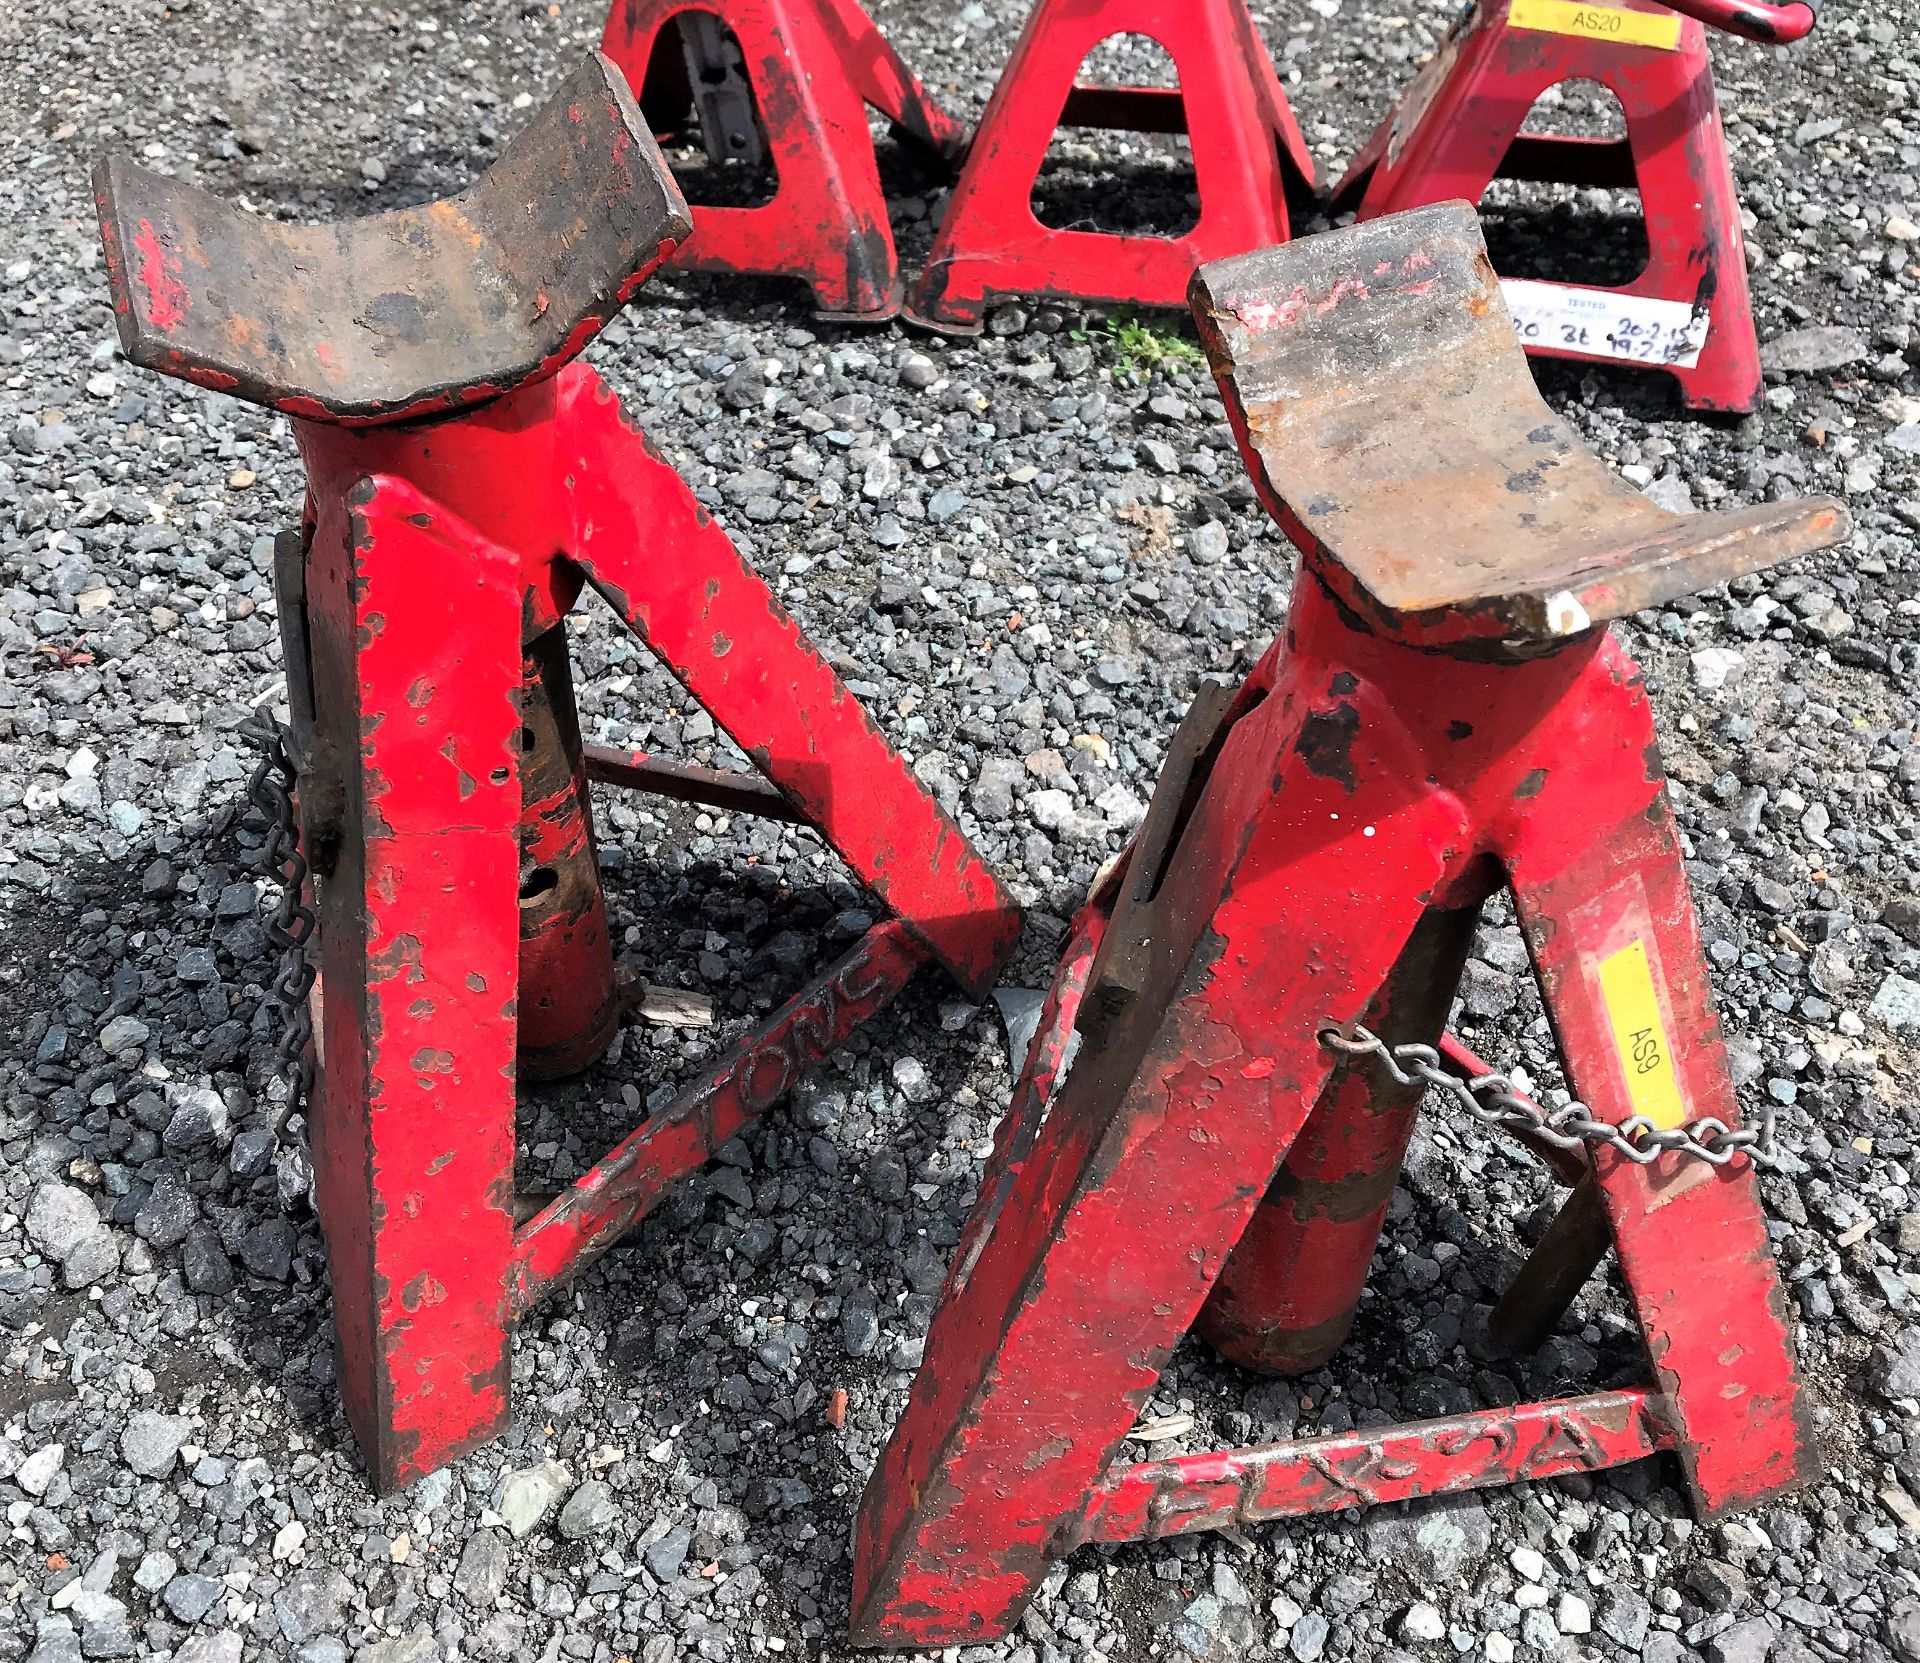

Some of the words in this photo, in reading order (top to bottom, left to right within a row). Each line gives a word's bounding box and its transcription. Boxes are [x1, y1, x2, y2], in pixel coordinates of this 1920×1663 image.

[1573, 11, 1621, 33] AS20
[1568, 298, 1606, 310] TESTED
[1629, 1027, 1661, 1075] AS9
